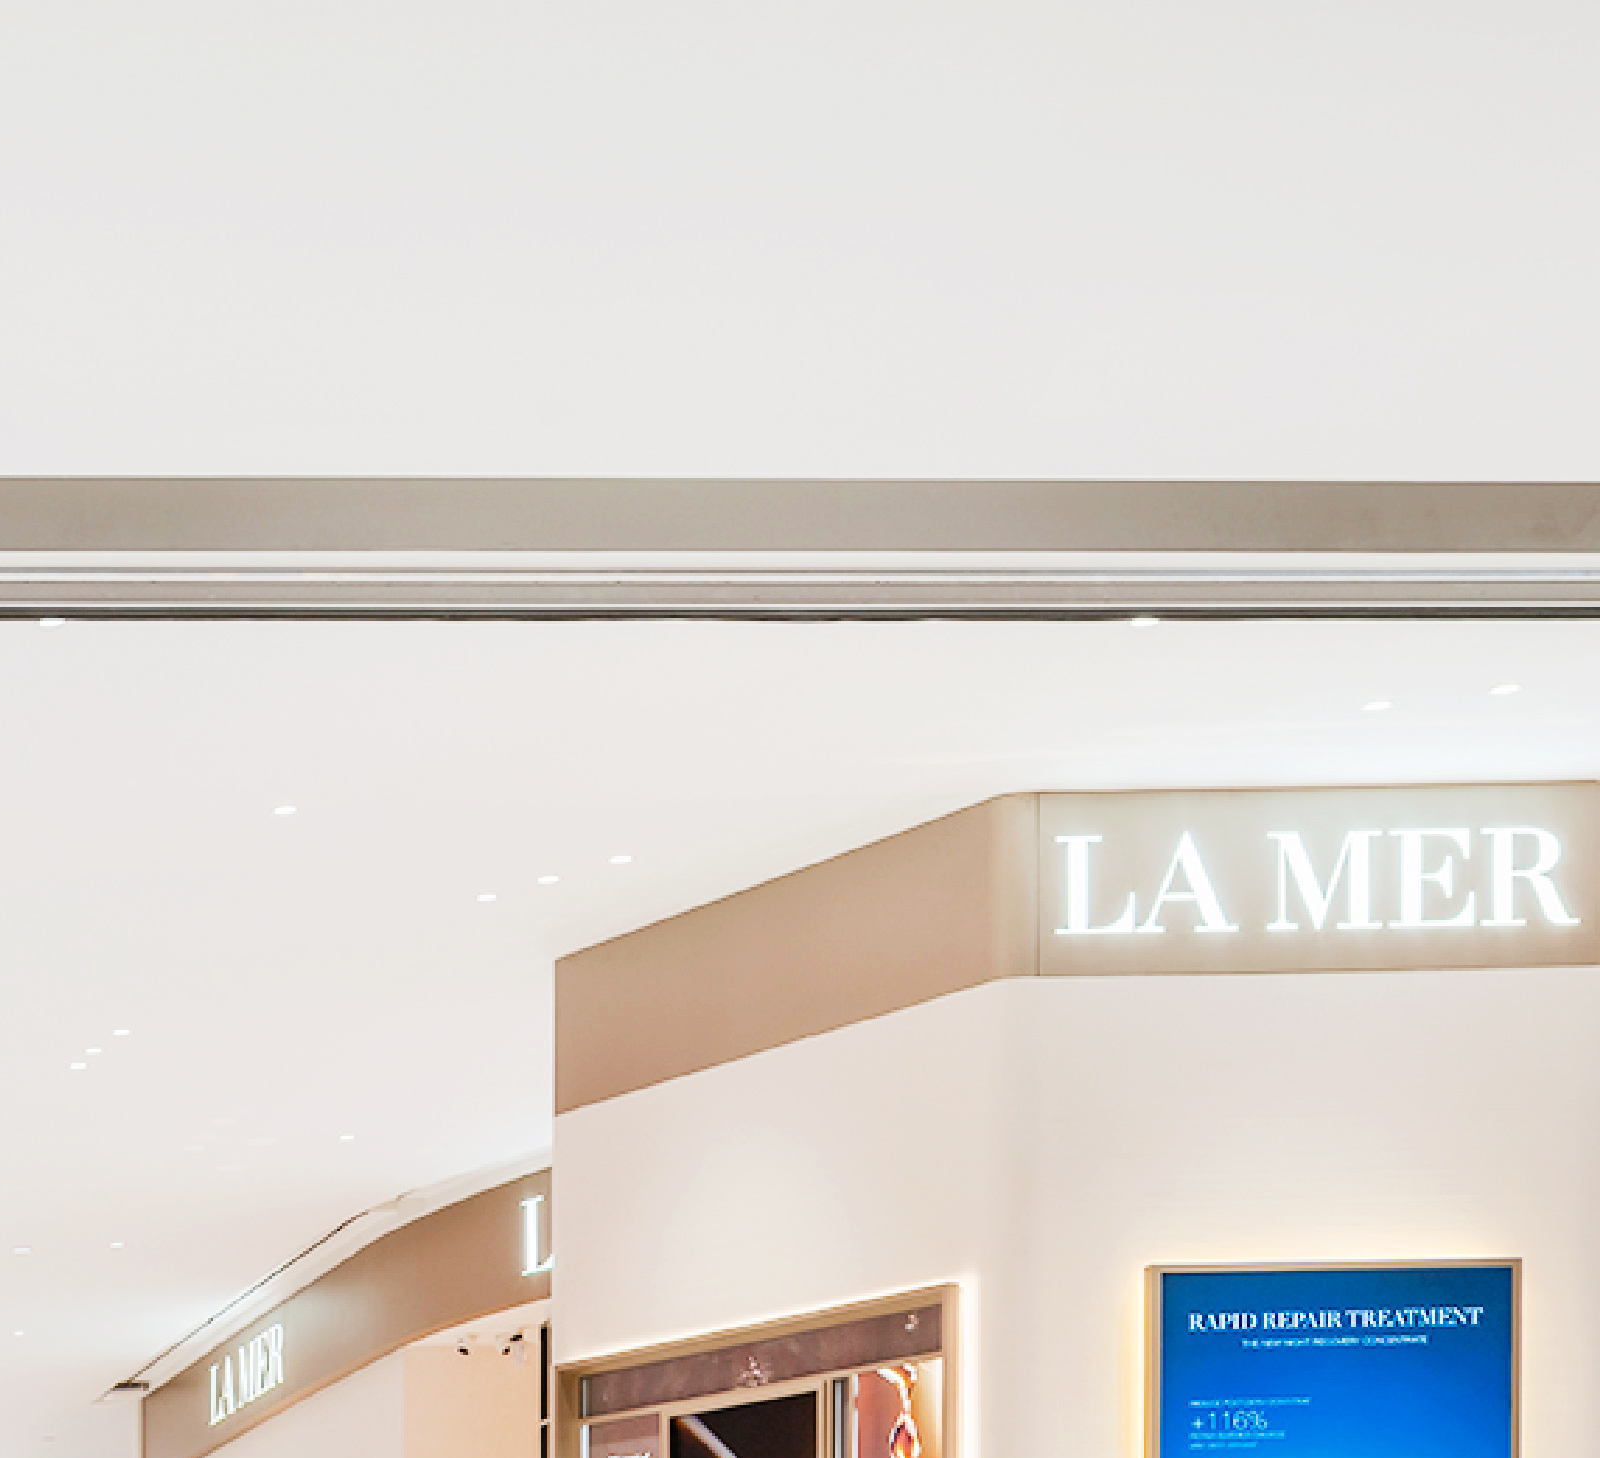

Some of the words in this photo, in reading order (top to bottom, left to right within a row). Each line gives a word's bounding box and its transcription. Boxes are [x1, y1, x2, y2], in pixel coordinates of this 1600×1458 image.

[1053, 829, 1240, 936] LA
[1266, 824, 1582, 932] MER
[519, 1194, 554, 1278] L
[1188, 1310, 1257, 1332] RAPID
[1262, 1308, 1343, 1331] REPAIR
[1345, 1306, 1484, 1330] TREATMENT
[208, 1358, 237, 1426] LA
[238, 1323, 285, 1410] MER
[1191, 1410, 1268, 1430] +116%
